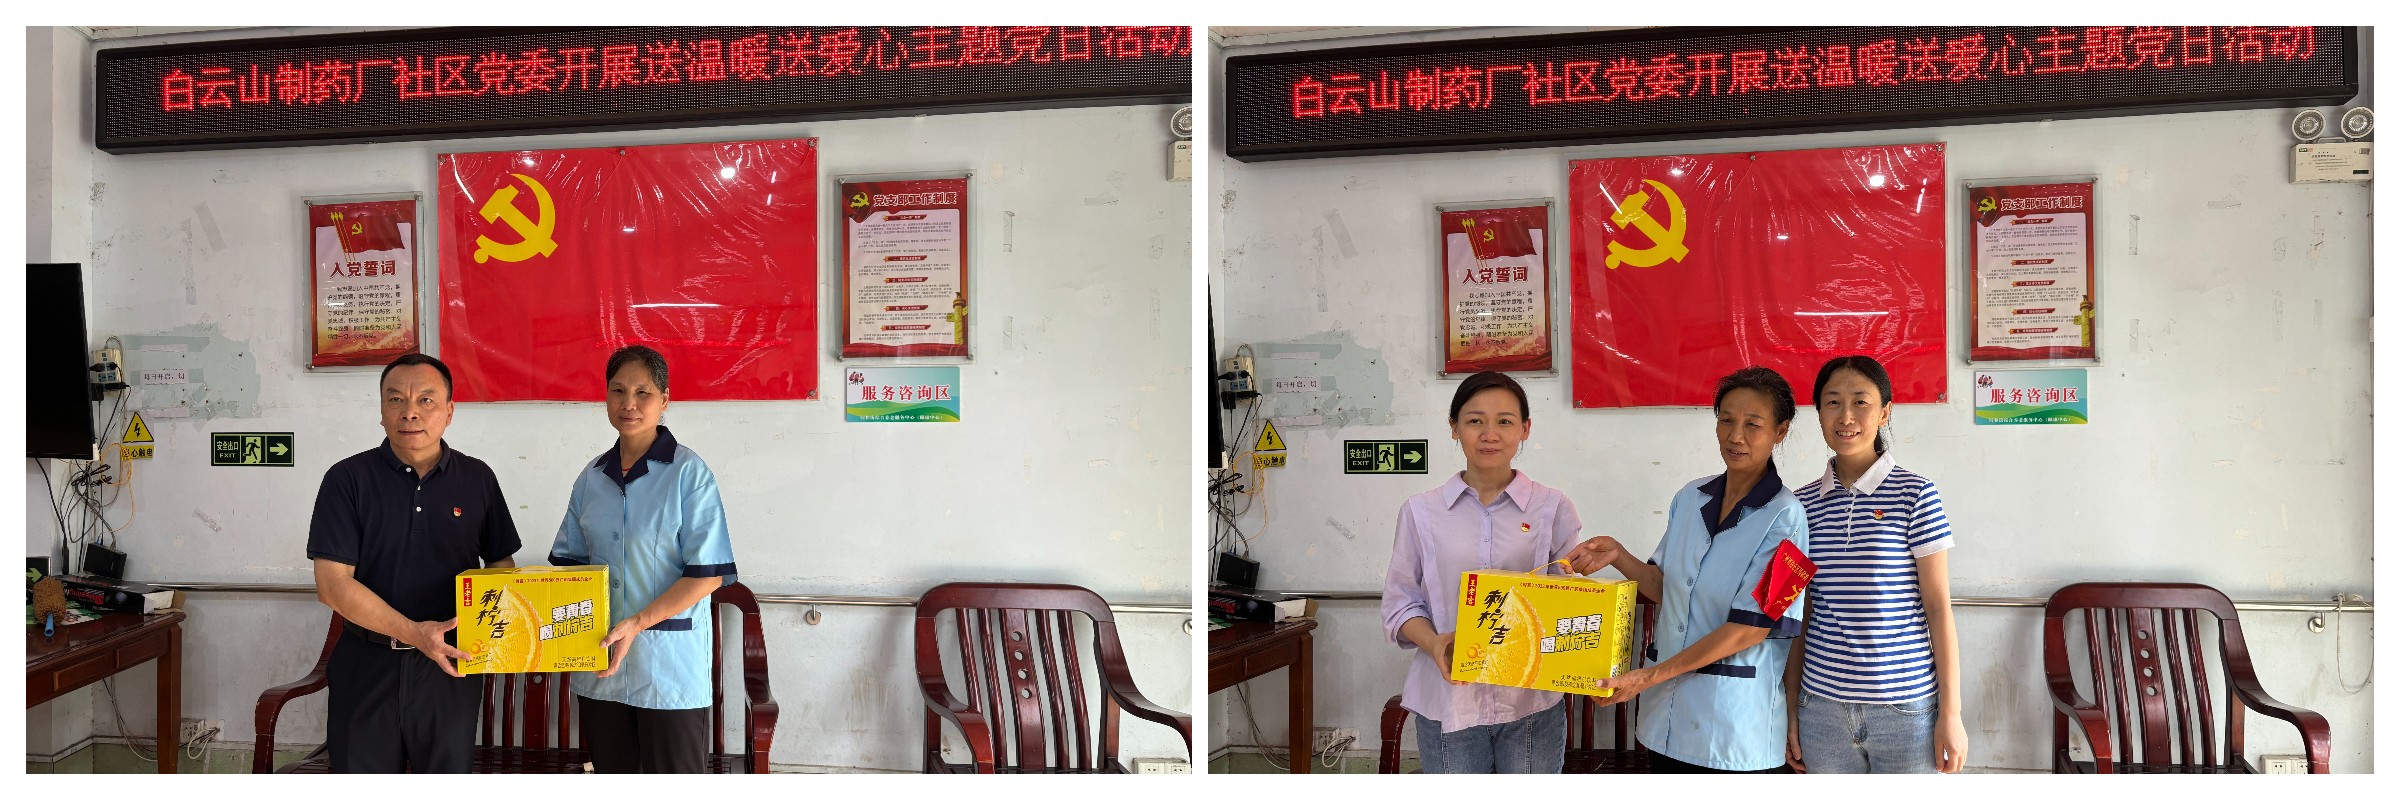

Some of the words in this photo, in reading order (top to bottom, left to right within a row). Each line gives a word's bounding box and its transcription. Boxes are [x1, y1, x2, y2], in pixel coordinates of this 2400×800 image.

[161, 26, 1192, 112] 白云山制药厂社区党委开展送温暖送爱心主题党日活动
[1291, 26, 2315, 119] 白云山制药厂社区党委开展送温暖送爱心主题党日活动
[873, 192, 957, 206] 党支部工作制度
[2001, 196, 2083, 211] 党支部工作制度
[329, 260, 397, 280] 入党誓词
[1461, 266, 1529, 287] 入党誓词
[862, 384, 952, 401] 服务咨询区
[1990, 387, 2080, 404] 服务咨询区
[216, 440, 239, 451] 安全出口
[1349, 448, 1372, 459] 安全出口
[463, 580, 472, 606] 王老吉
[1467, 578, 1476, 606] 王老吉
[476, 588, 509, 639] 刺柠吉
[551, 598, 594, 622] 要青春
[1477, 589, 1511, 645] 刺柠吉
[539, 615, 594, 641] 喝刺柠吉
[1556, 613, 1602, 634] 要青春
[1540, 632, 1601, 654] 喝刺柠吉
